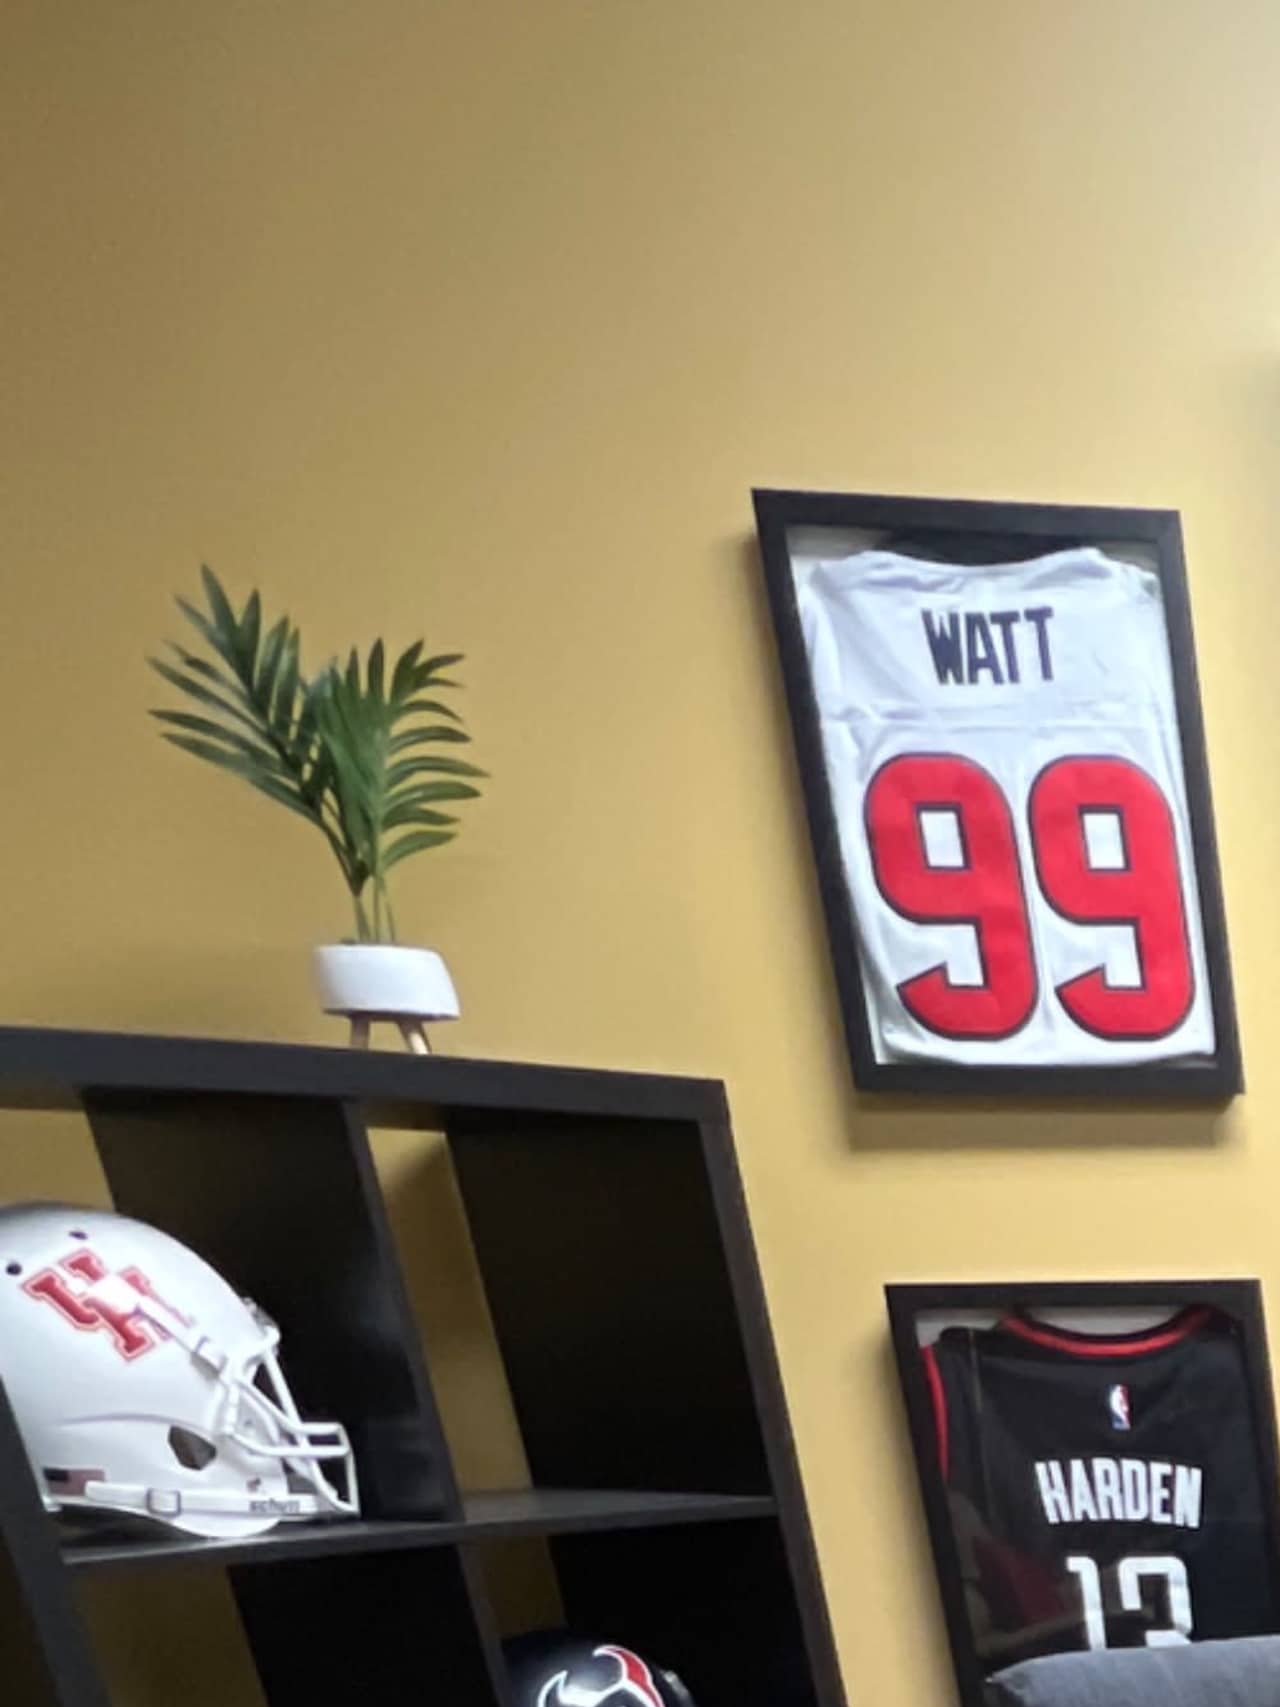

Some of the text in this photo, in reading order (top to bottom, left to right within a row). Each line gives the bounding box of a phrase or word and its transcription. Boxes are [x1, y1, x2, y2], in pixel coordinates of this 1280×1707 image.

[924, 606, 1055, 686] WATT
[863, 752, 1196, 1042] 99
[1033, 1457, 1203, 1530] HARDEN
